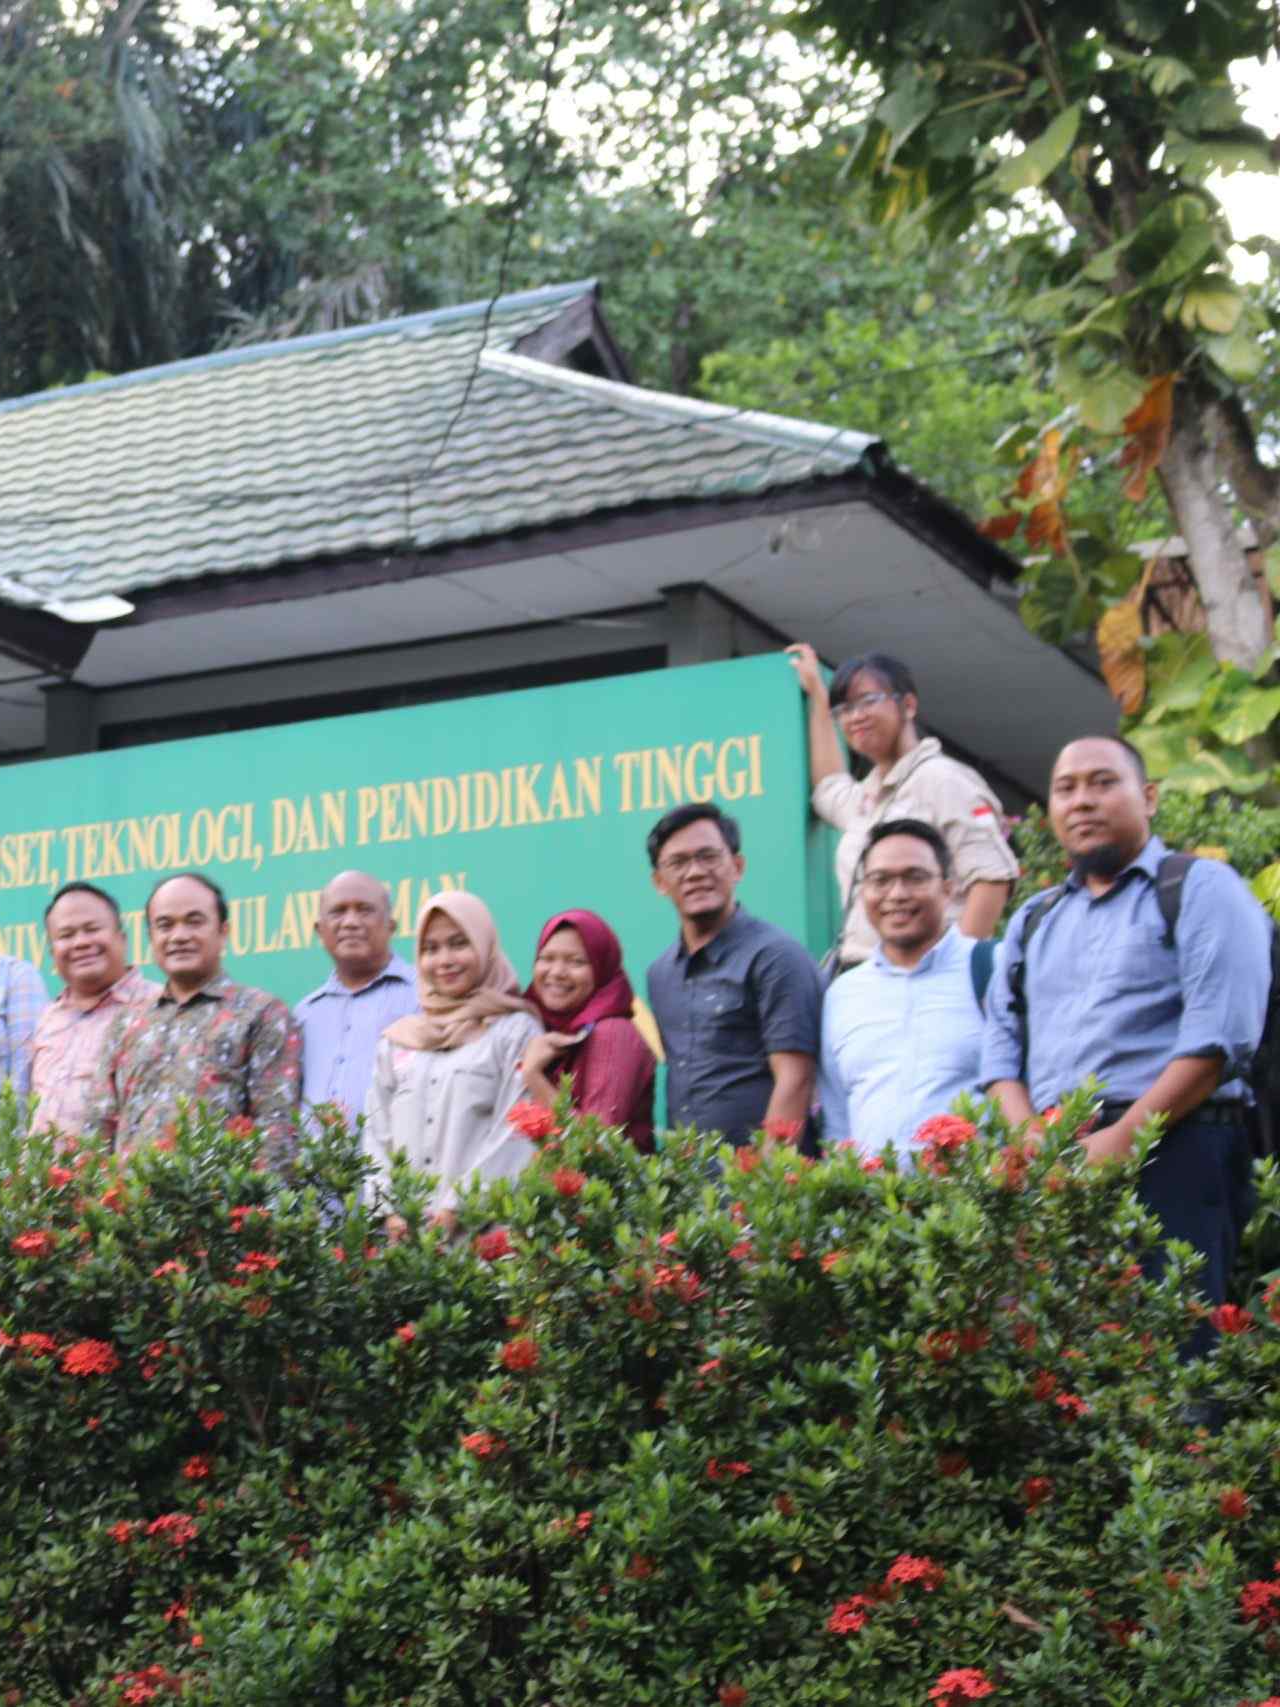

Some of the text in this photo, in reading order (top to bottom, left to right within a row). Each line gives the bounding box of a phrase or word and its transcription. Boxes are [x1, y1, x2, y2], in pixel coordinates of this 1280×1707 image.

[62, 802, 264, 881] TEKNOLOGI,
[271, 790, 349, 855] DAN
[357, 756, 605, 846] PENDIDIKAN
[614, 735, 764, 814] TINGGI
